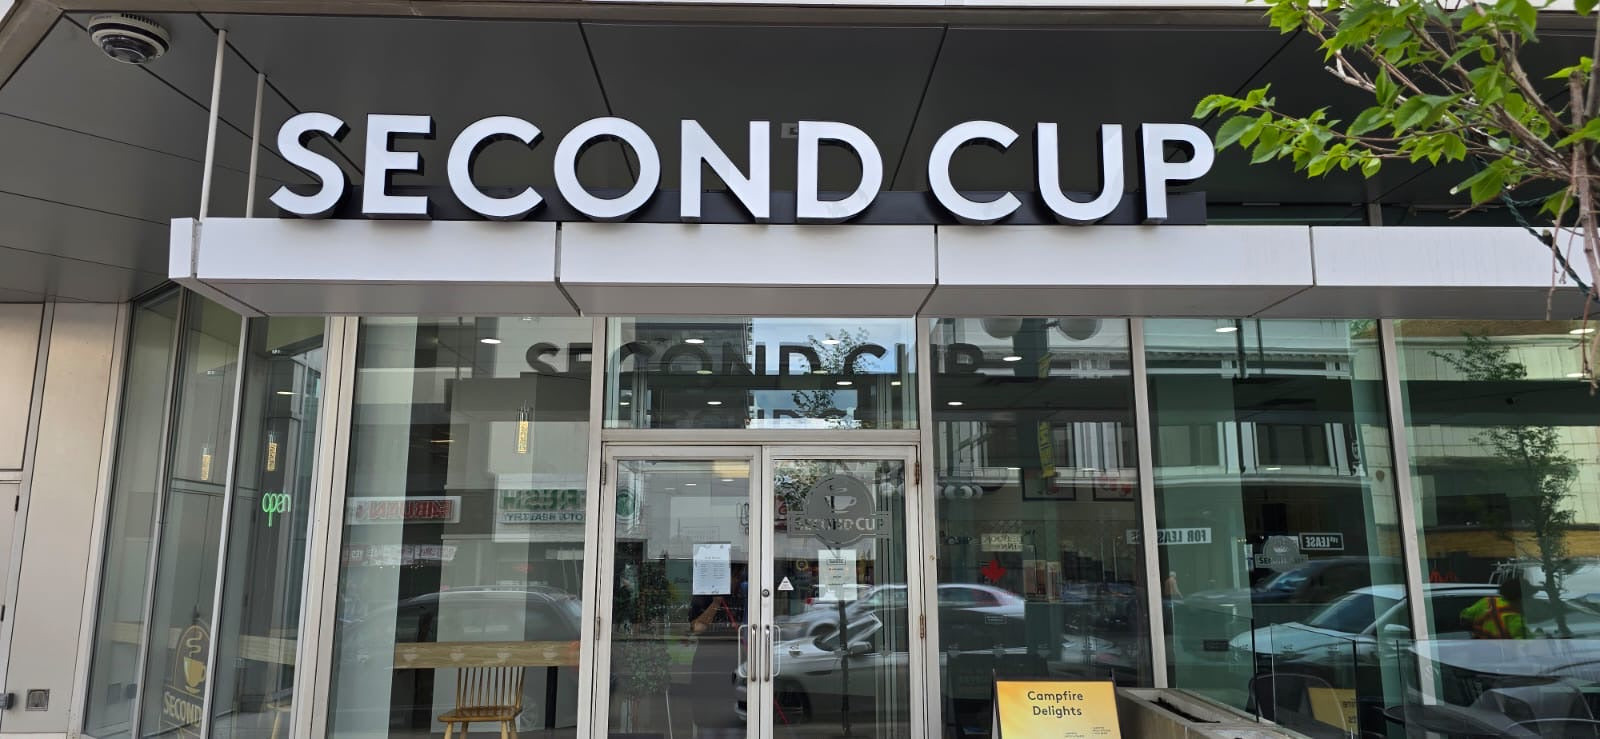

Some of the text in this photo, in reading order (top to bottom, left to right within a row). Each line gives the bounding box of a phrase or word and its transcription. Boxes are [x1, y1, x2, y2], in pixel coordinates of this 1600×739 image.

[268, 112, 1216, 221] SECOND CUP
[262, 492, 292, 528] open
[794, 518, 854, 531] SECOND
[163, 690, 204, 728] SECOND
[1027, 690, 1084, 703] Campfire
[1032, 705, 1082, 719] Delights
